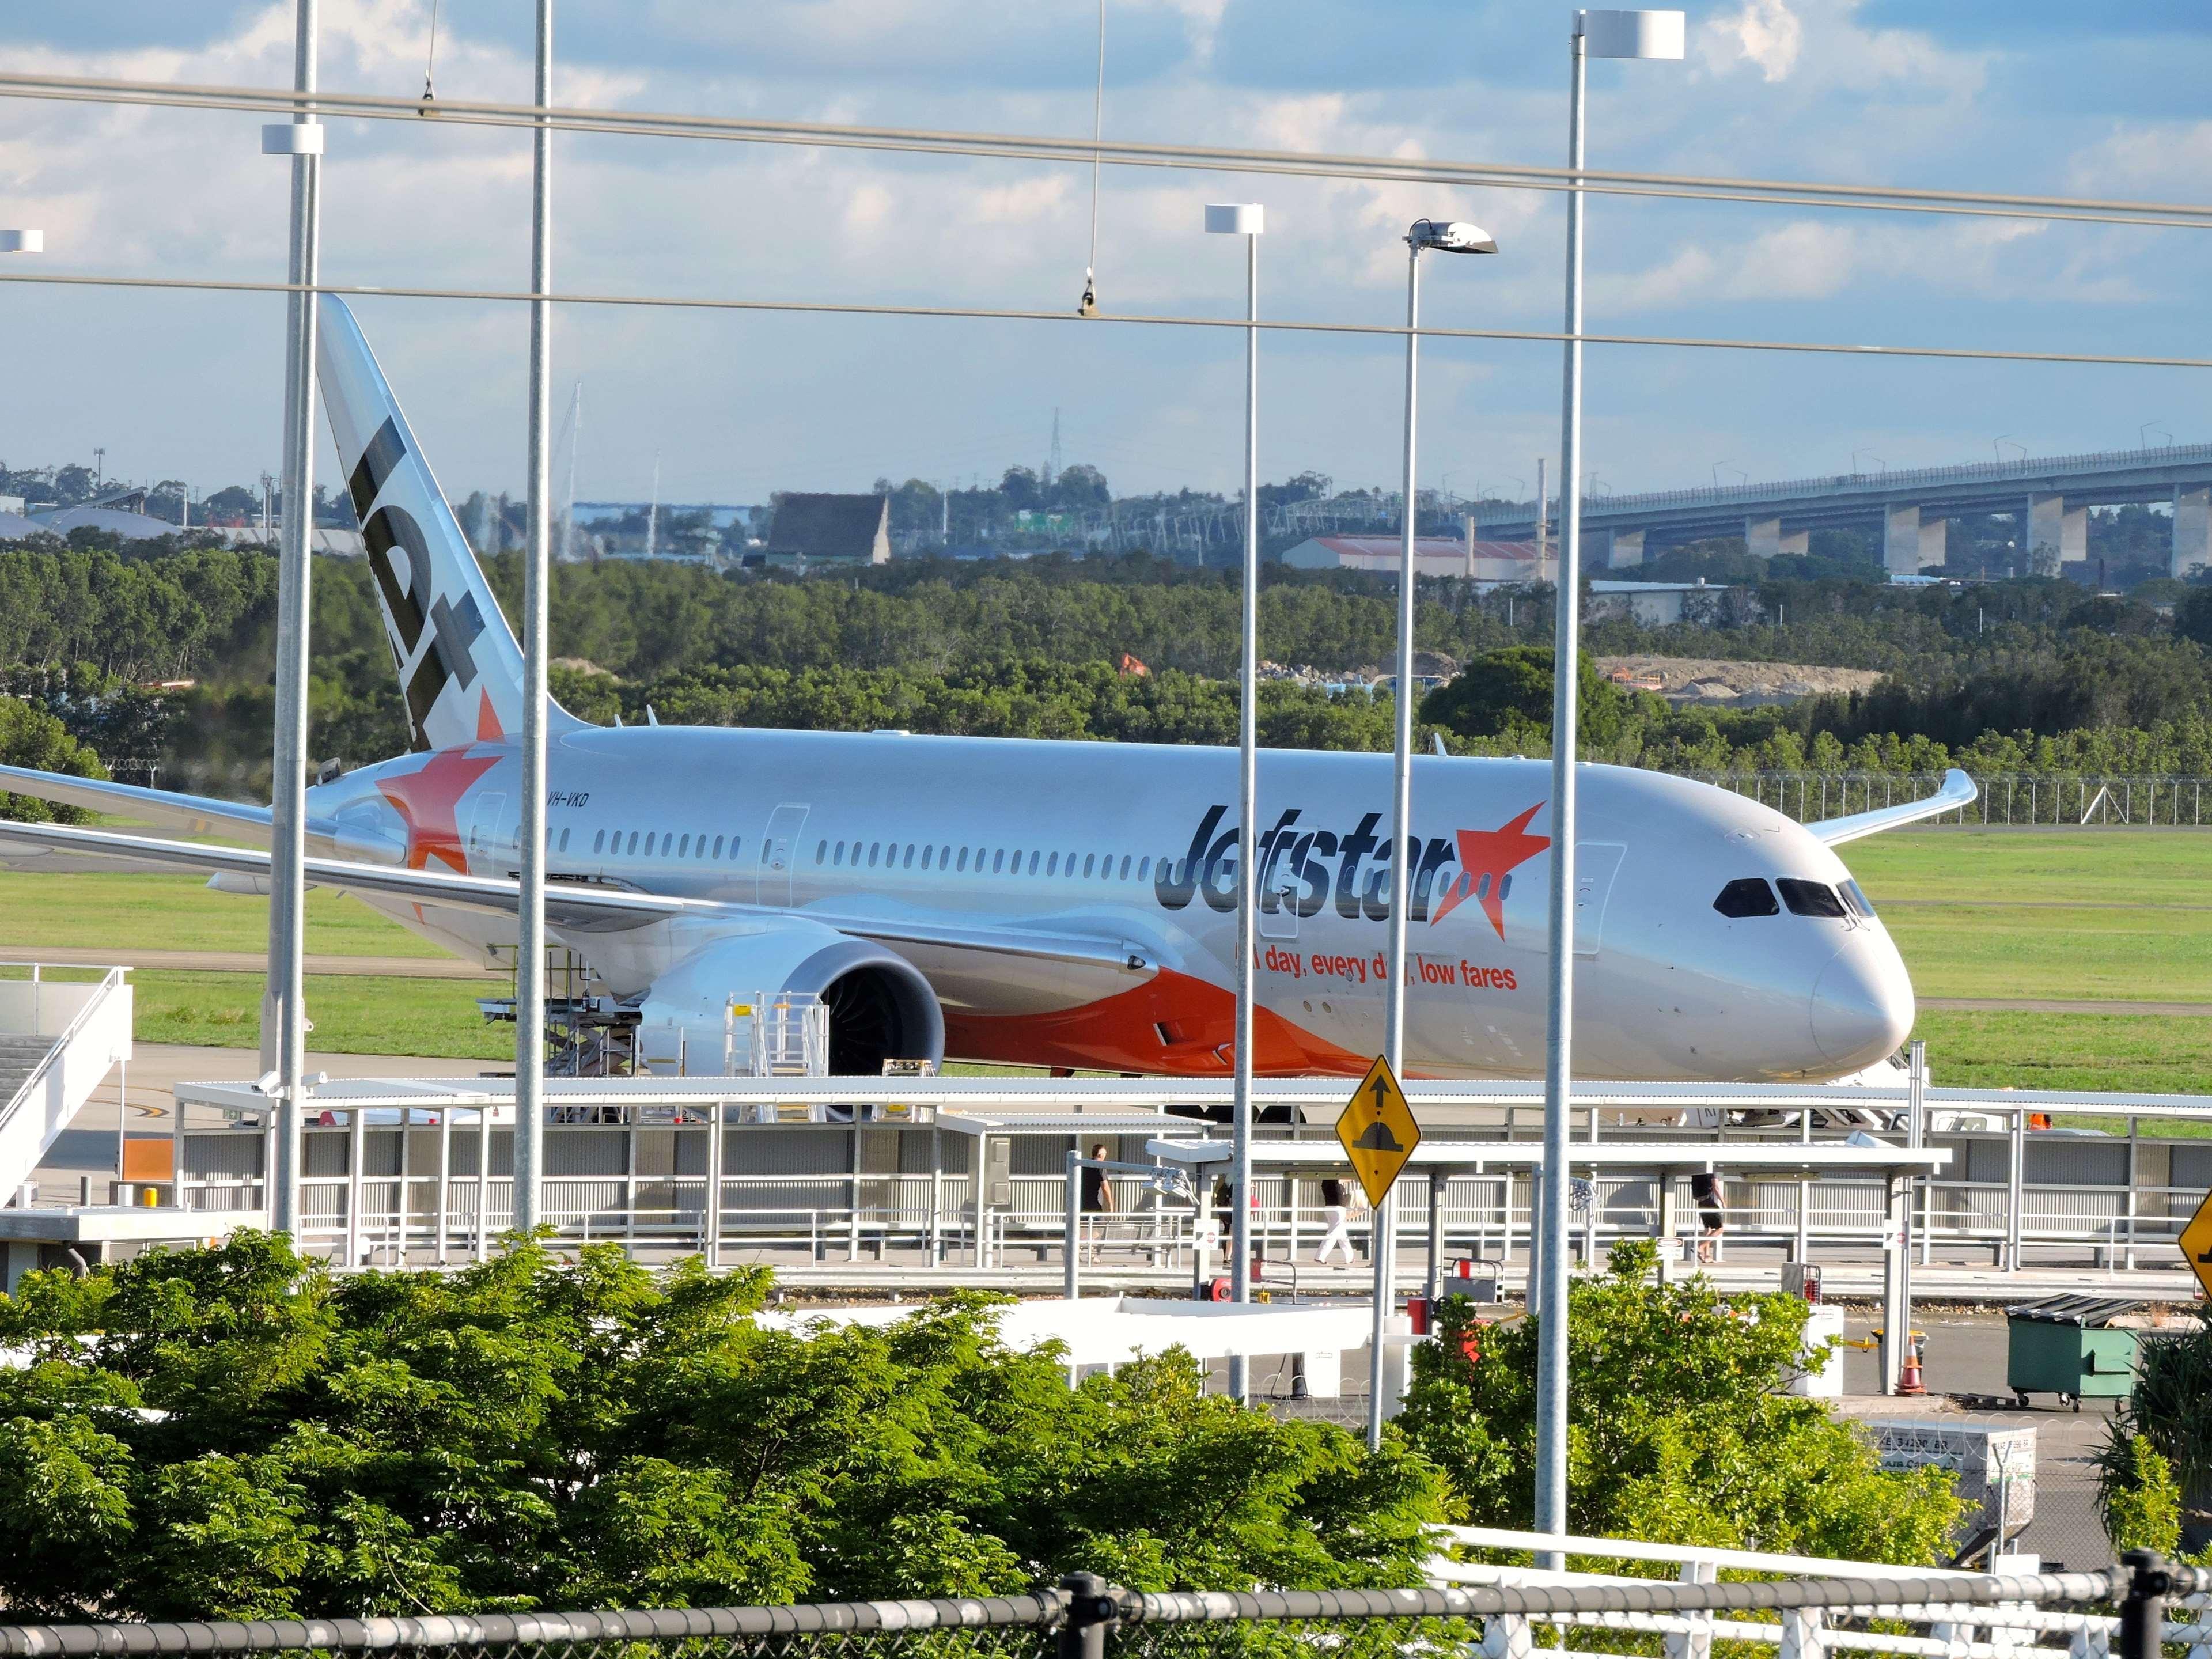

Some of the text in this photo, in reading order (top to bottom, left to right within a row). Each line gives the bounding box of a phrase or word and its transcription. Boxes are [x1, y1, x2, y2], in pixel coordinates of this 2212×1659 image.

[547, 791, 589, 807] VH-VKD
[1154, 805, 1456, 922] Jetstar
[1265, 945, 1307, 978] day,
[1311, 953, 1366, 983] every
[1417, 953, 1455, 985] low
[1460, 960, 1517, 990] fares
